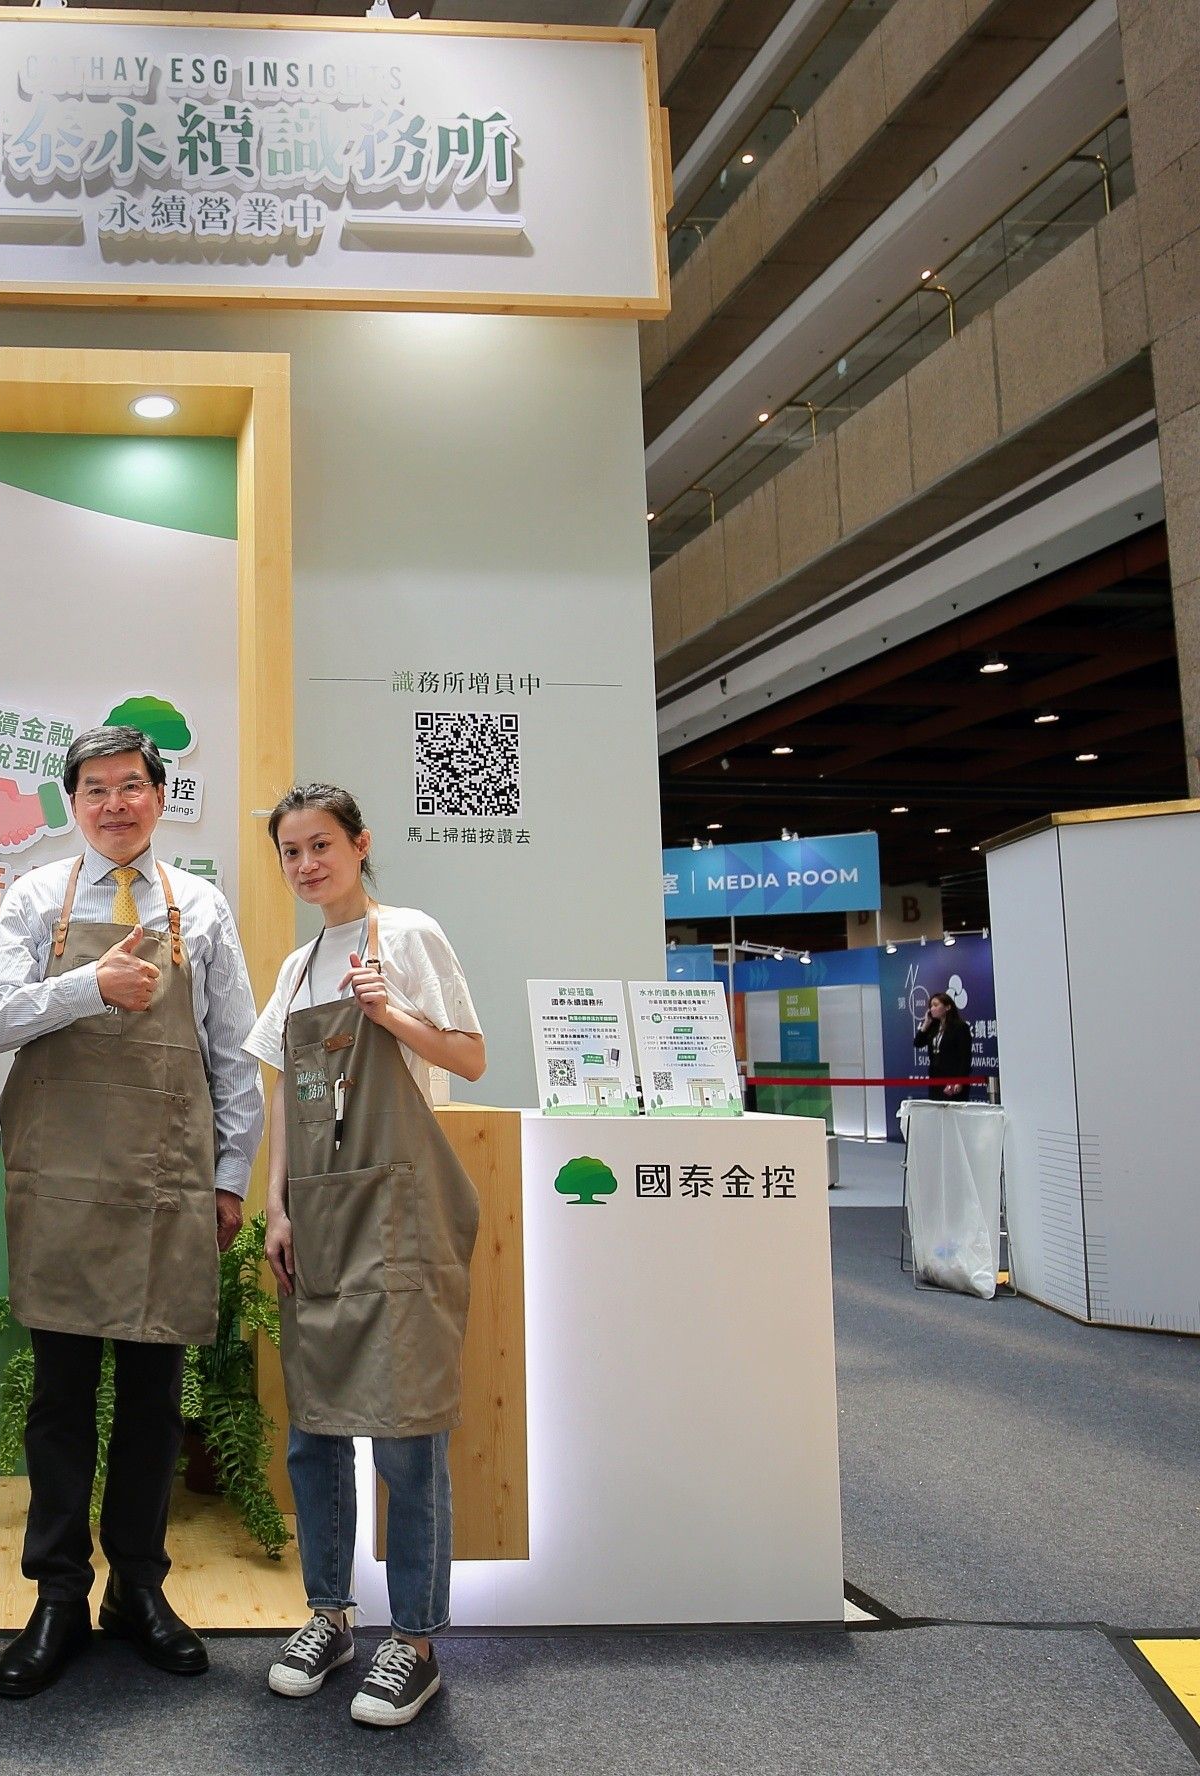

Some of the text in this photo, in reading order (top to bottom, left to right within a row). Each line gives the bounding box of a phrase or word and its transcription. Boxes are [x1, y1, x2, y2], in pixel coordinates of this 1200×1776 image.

[170, 57, 228, 85] ESG
[104, 193, 324, 233] 永續營業中
[391, 670, 541, 696] 識務所增員中
[164, 777, 196, 801] 控
[163, 804, 194, 815] oldings
[406, 826, 531, 845] 馬上掃描按讚去
[708, 867, 859, 891] MEDIA ROOM
[901, 895, 921, 922] B
[635, 1163, 797, 1199] 國泰金控
